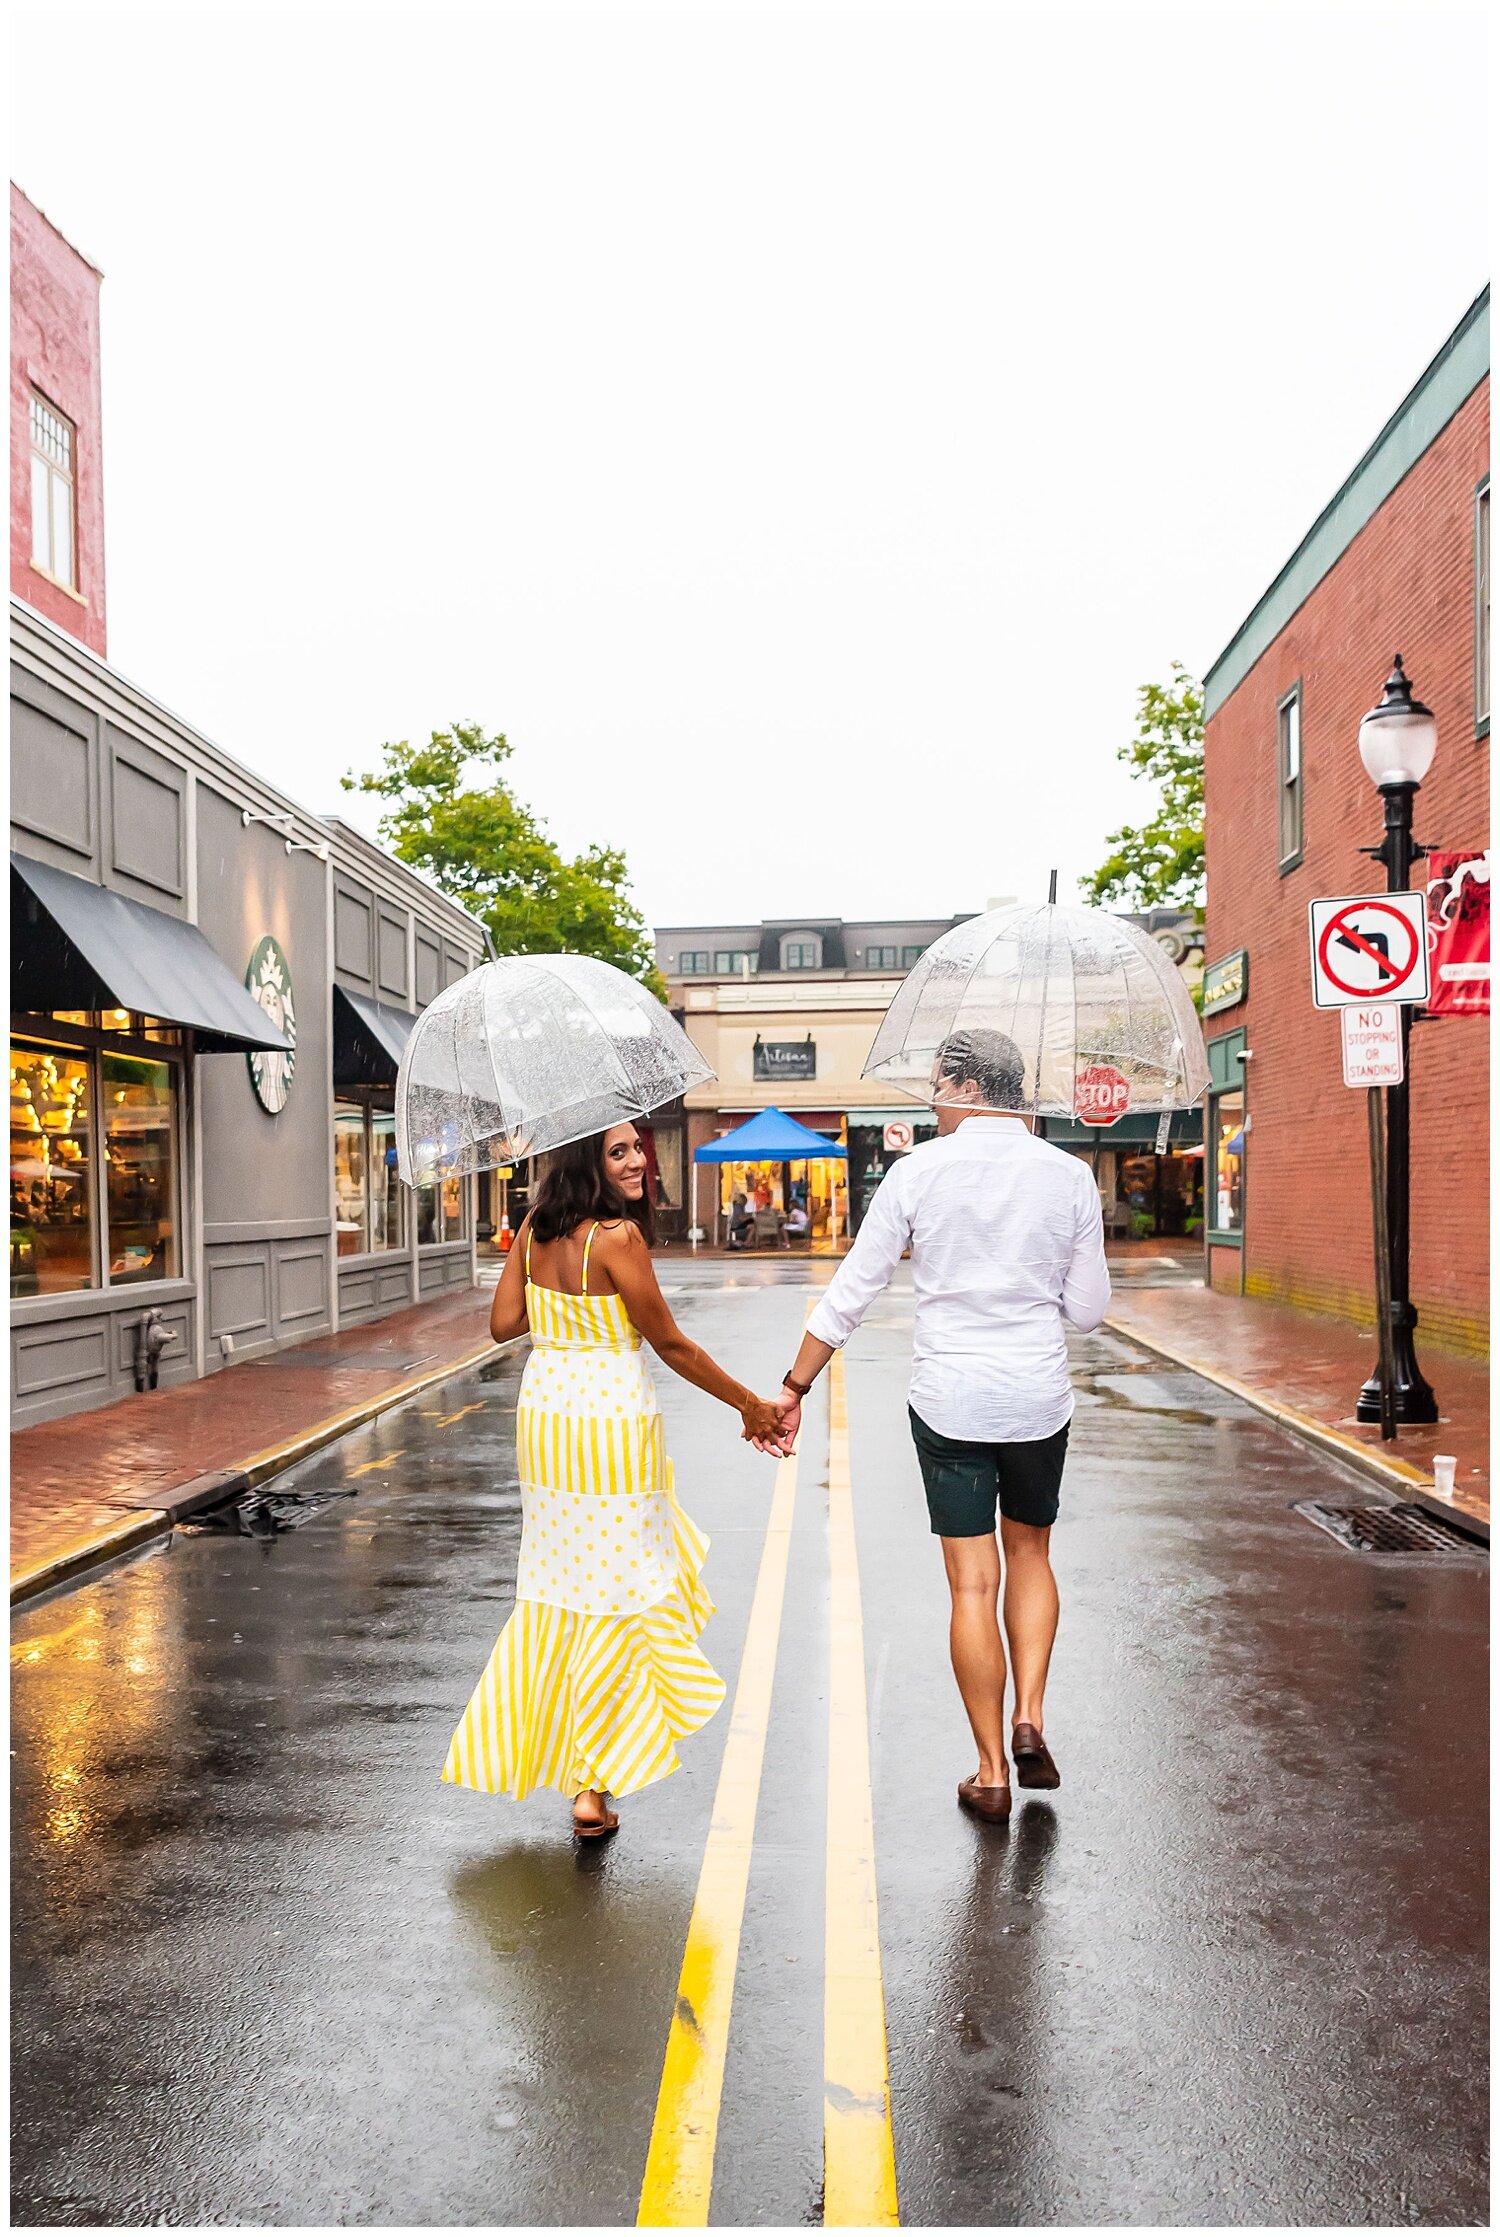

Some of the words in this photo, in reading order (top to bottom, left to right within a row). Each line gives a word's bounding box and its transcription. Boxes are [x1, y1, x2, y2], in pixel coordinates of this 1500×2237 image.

[1359, 1011, 1383, 1028] NO
[1348, 1031, 1396, 1045] STOPPING
[1365, 1048, 1379, 1060] OR
[1350, 1063, 1398, 1077] STANDING
[1075, 1083, 1127, 1107] STOP
